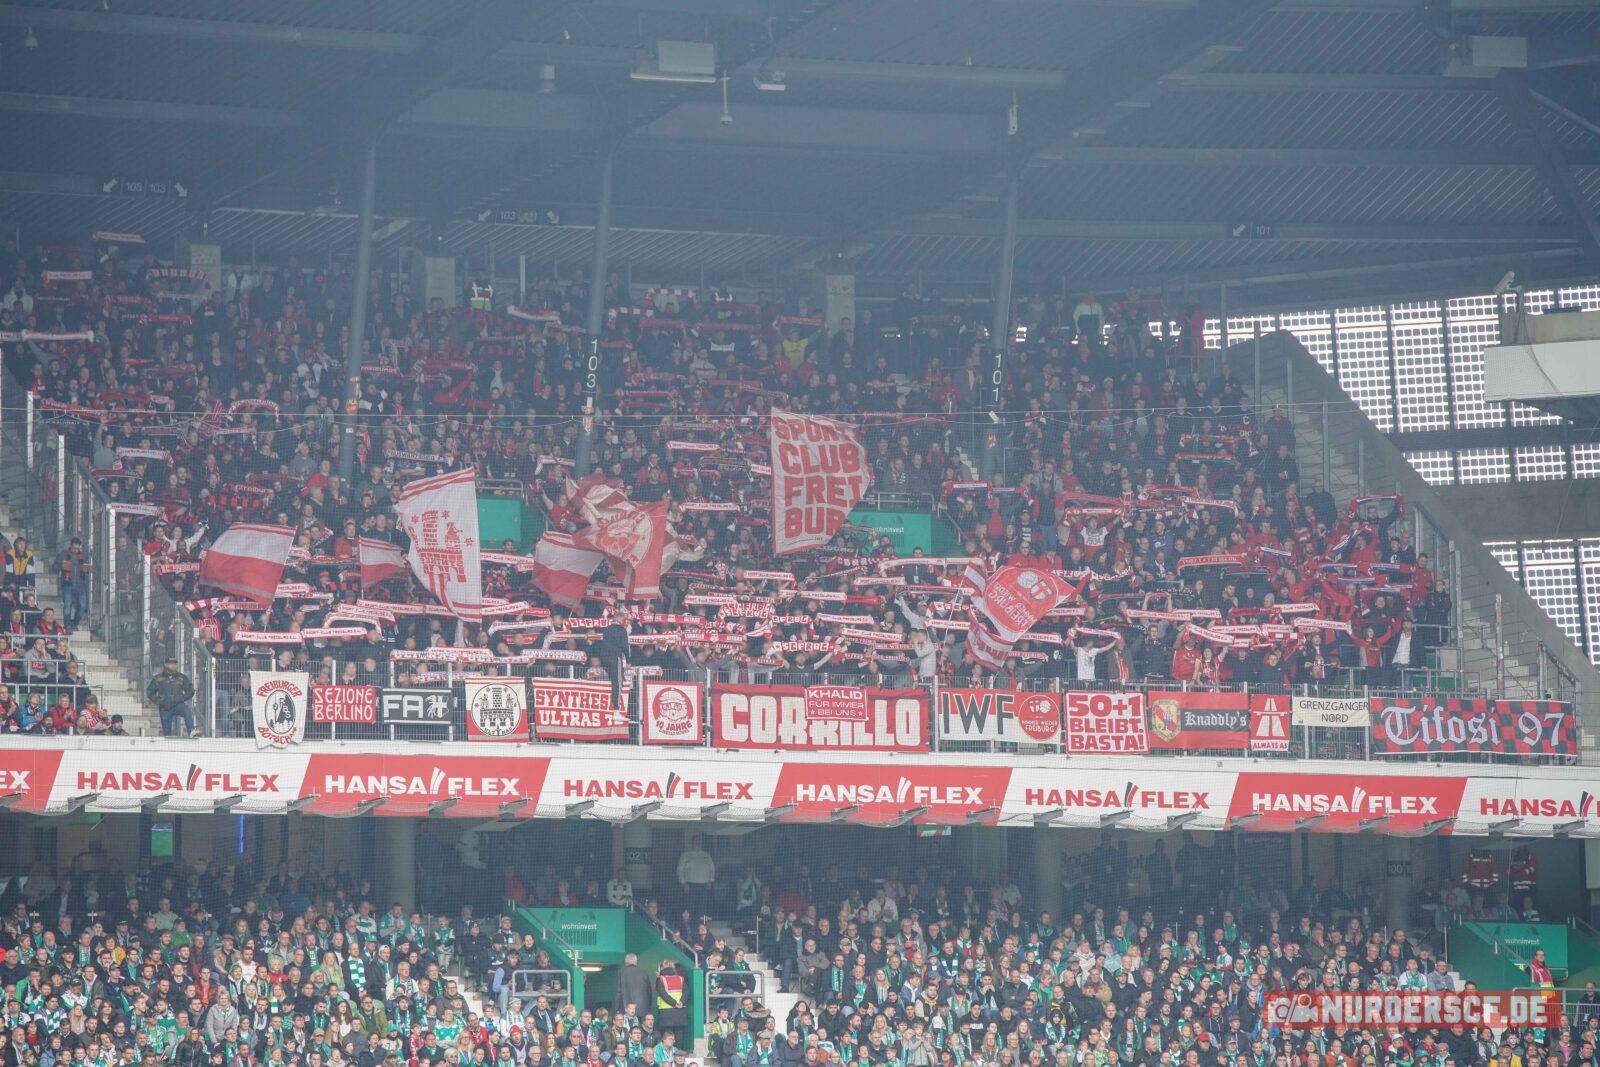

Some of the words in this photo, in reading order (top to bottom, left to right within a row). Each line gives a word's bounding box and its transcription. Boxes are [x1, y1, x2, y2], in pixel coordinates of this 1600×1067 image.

[586, 338, 598, 388] 103
[992, 353, 1002, 402] 101
[778, 442, 861, 475] CLUB
[257, 680, 302, 697] FREIBURGER
[314, 688, 373, 704] SEZIONE
[809, 689, 863, 700] KHALID
[314, 704, 373, 720] BERLINO
[809, 699, 829, 708] FÜR
[833, 701, 864, 709] IMMER
[835, 709, 856, 717] UNS
[1068, 694, 1141, 717] 50+1
[539, 710, 600, 727] ULTRAS
[941, 692, 1015, 735] IWF
[1184, 711, 1247, 728] Knaddly's
[1321, 713, 1349, 723] NORD
[656, 720, 665, 728] 10
[666, 720, 692, 731] JAHRE
[1070, 718, 1144, 733] BLEIBT.
[1381, 704, 1500, 745] Tifosi
[1518, 711, 1565, 747] 97
[1071, 734, 1145, 750] BASTA!
[77, 772, 183, 791] HANSA
[205, 774, 279, 792] FLEX
[325, 774, 431, 794] HANSA
[448, 777, 519, 795] FLEX
[564, 779, 661, 798] HANSA
[684, 781, 753, 800] FLEX
[796, 784, 895, 803] HANSA
[920, 785, 983, 804] FLEX
[1026, 788, 1122, 807] HANSA
[1141, 790, 1210, 809] FLEX
[1252, 793, 1354, 813] HANSA
[1369, 795, 1437, 814] FLEX
[1480, 797, 1577, 817] HANSA
[561, 922, 597, 930] wohninvest
